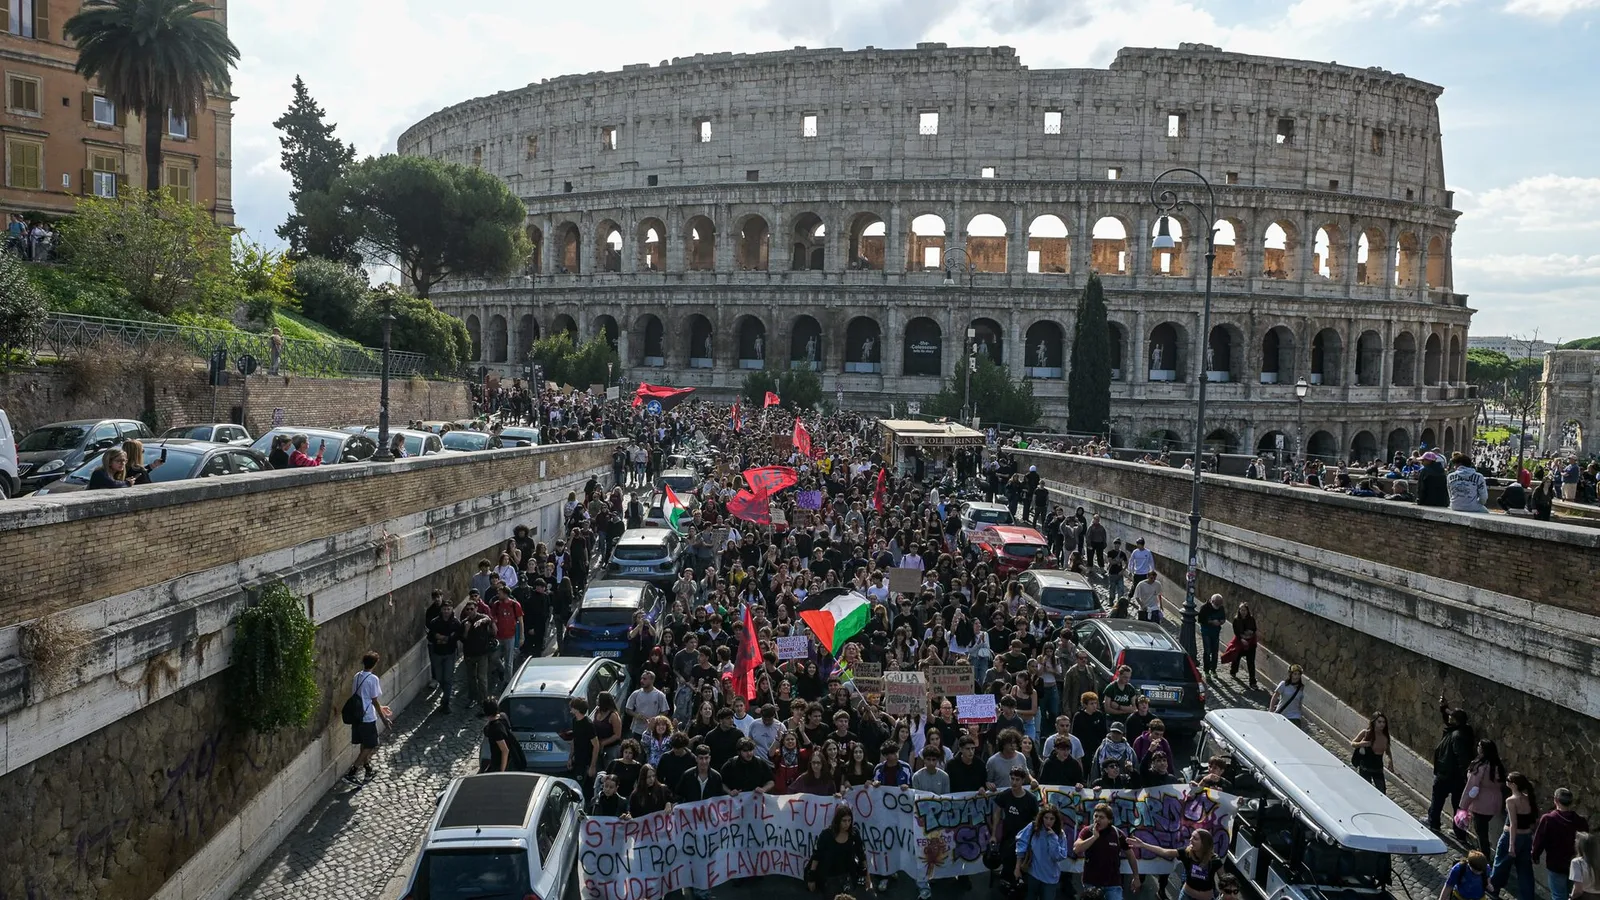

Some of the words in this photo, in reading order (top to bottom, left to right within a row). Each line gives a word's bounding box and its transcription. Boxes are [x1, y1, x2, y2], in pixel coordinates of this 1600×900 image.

[788, 790, 873, 827] FUTO
[581, 843, 678, 877] CONTRO
[707, 860, 720, 889] E
